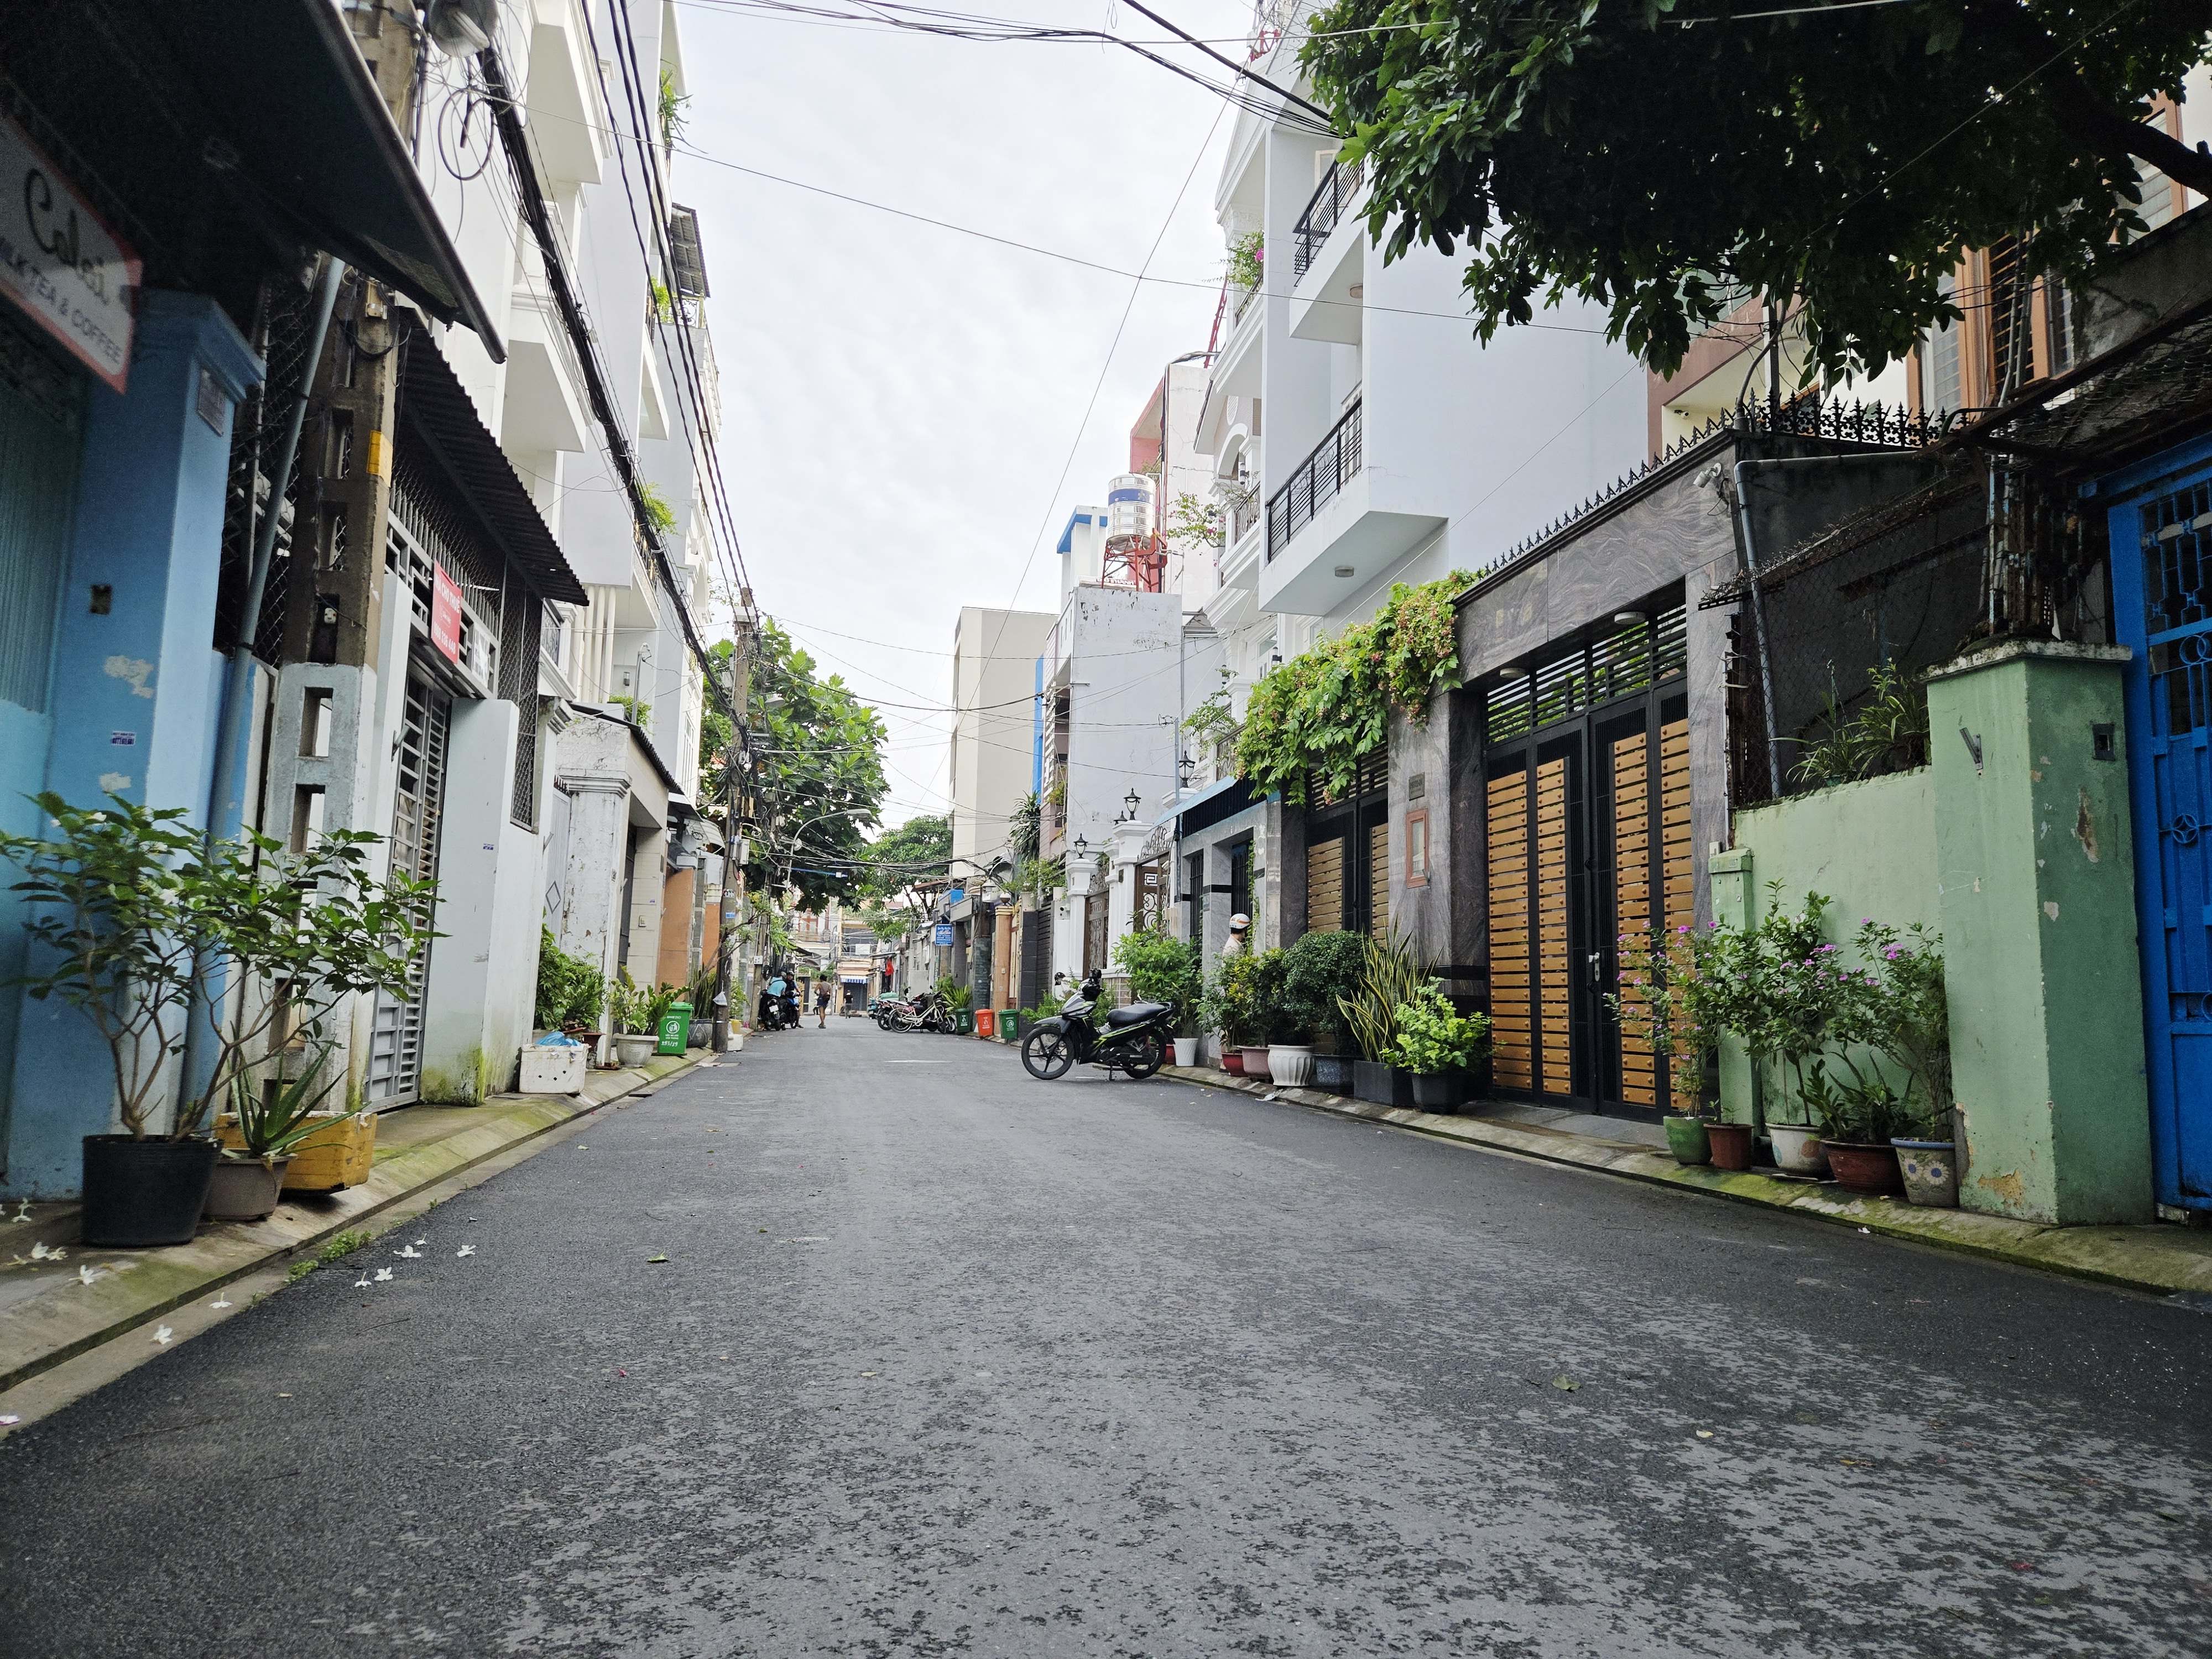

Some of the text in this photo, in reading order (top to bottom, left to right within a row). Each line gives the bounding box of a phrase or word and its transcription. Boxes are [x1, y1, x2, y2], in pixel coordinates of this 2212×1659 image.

[58, 298, 69, 317] &
[71, 308, 122, 365] COFFEE
[441, 582, 450, 603] CHO
[450, 591, 460, 614] THUÊ
